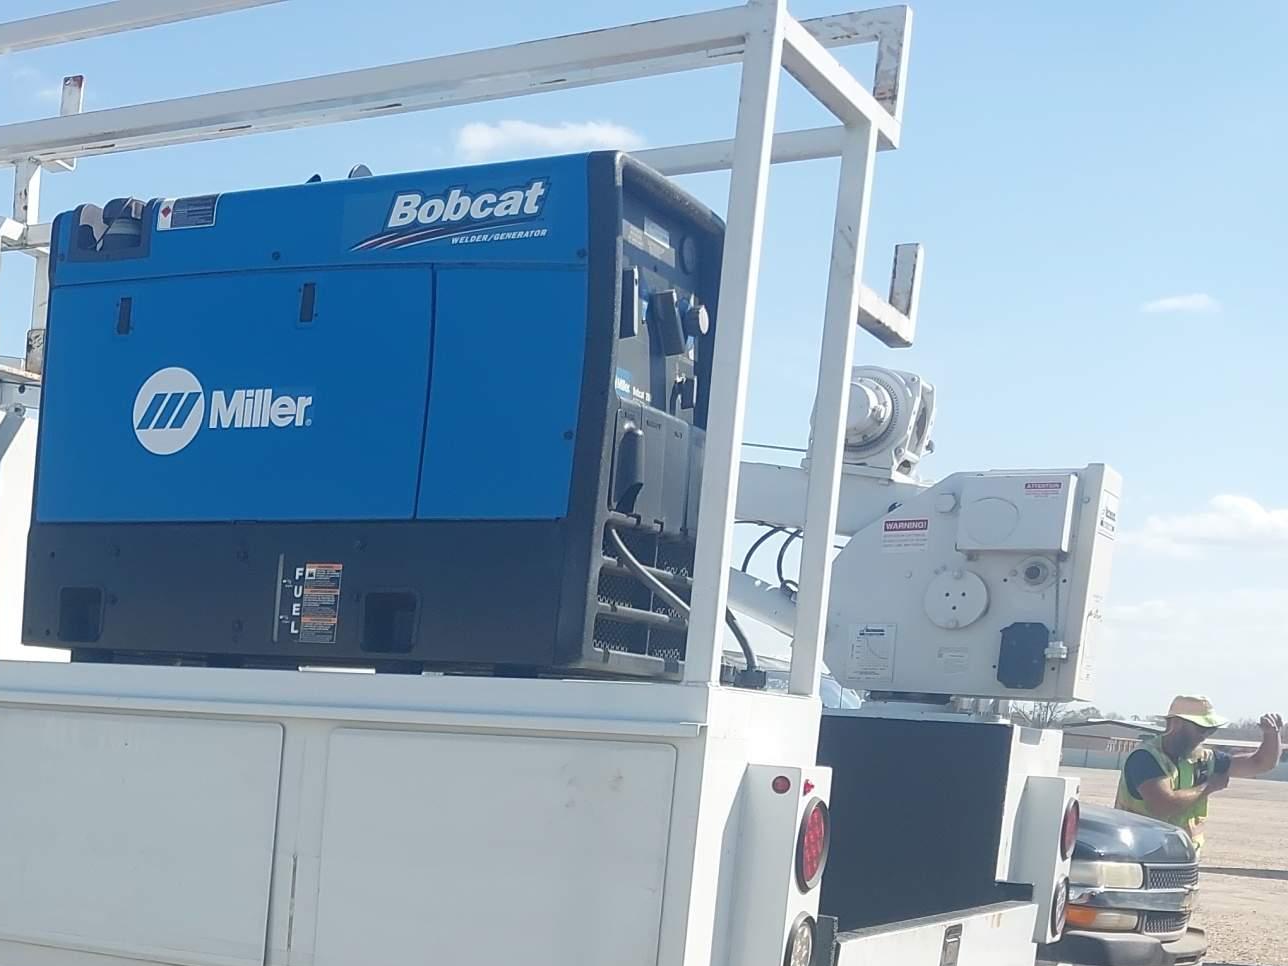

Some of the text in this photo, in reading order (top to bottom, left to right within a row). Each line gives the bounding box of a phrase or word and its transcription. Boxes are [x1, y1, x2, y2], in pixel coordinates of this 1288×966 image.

[387, 181, 545, 228] Bobcat
[451, 229, 547, 244] WELDER/GENERATOR
[208, 388, 312, 429] Miller
[885, 520, 928, 530] WARNING!
